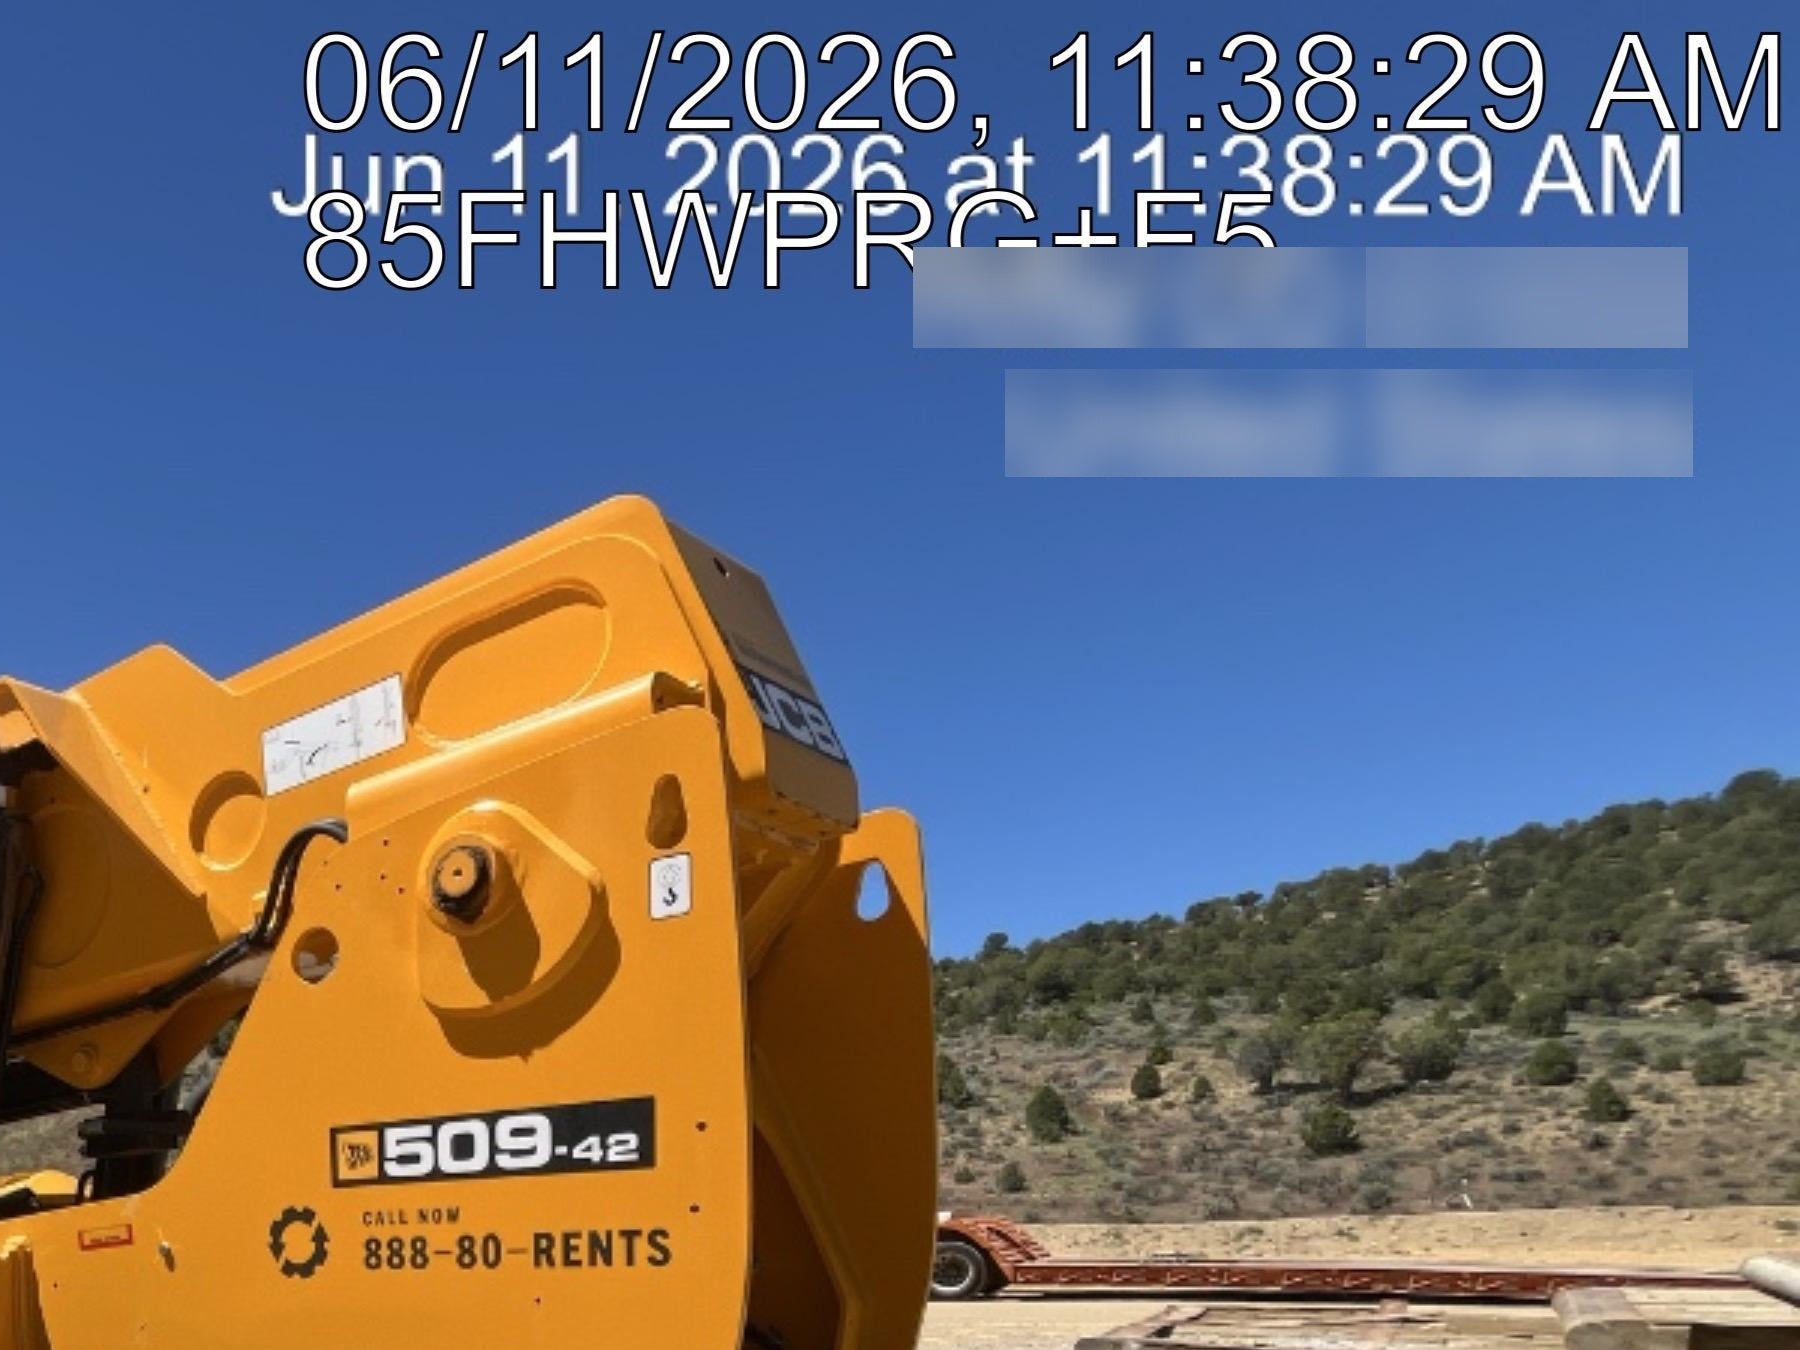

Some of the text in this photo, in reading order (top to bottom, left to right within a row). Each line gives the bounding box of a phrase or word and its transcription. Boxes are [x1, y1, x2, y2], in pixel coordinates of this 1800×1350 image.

[749, 673, 847, 761] JCB
[383, 1113, 640, 1177] 509-42
[361, 1206, 461, 1226] CALL NOW
[363, 1229, 672, 1269] 888-80-RENTS
